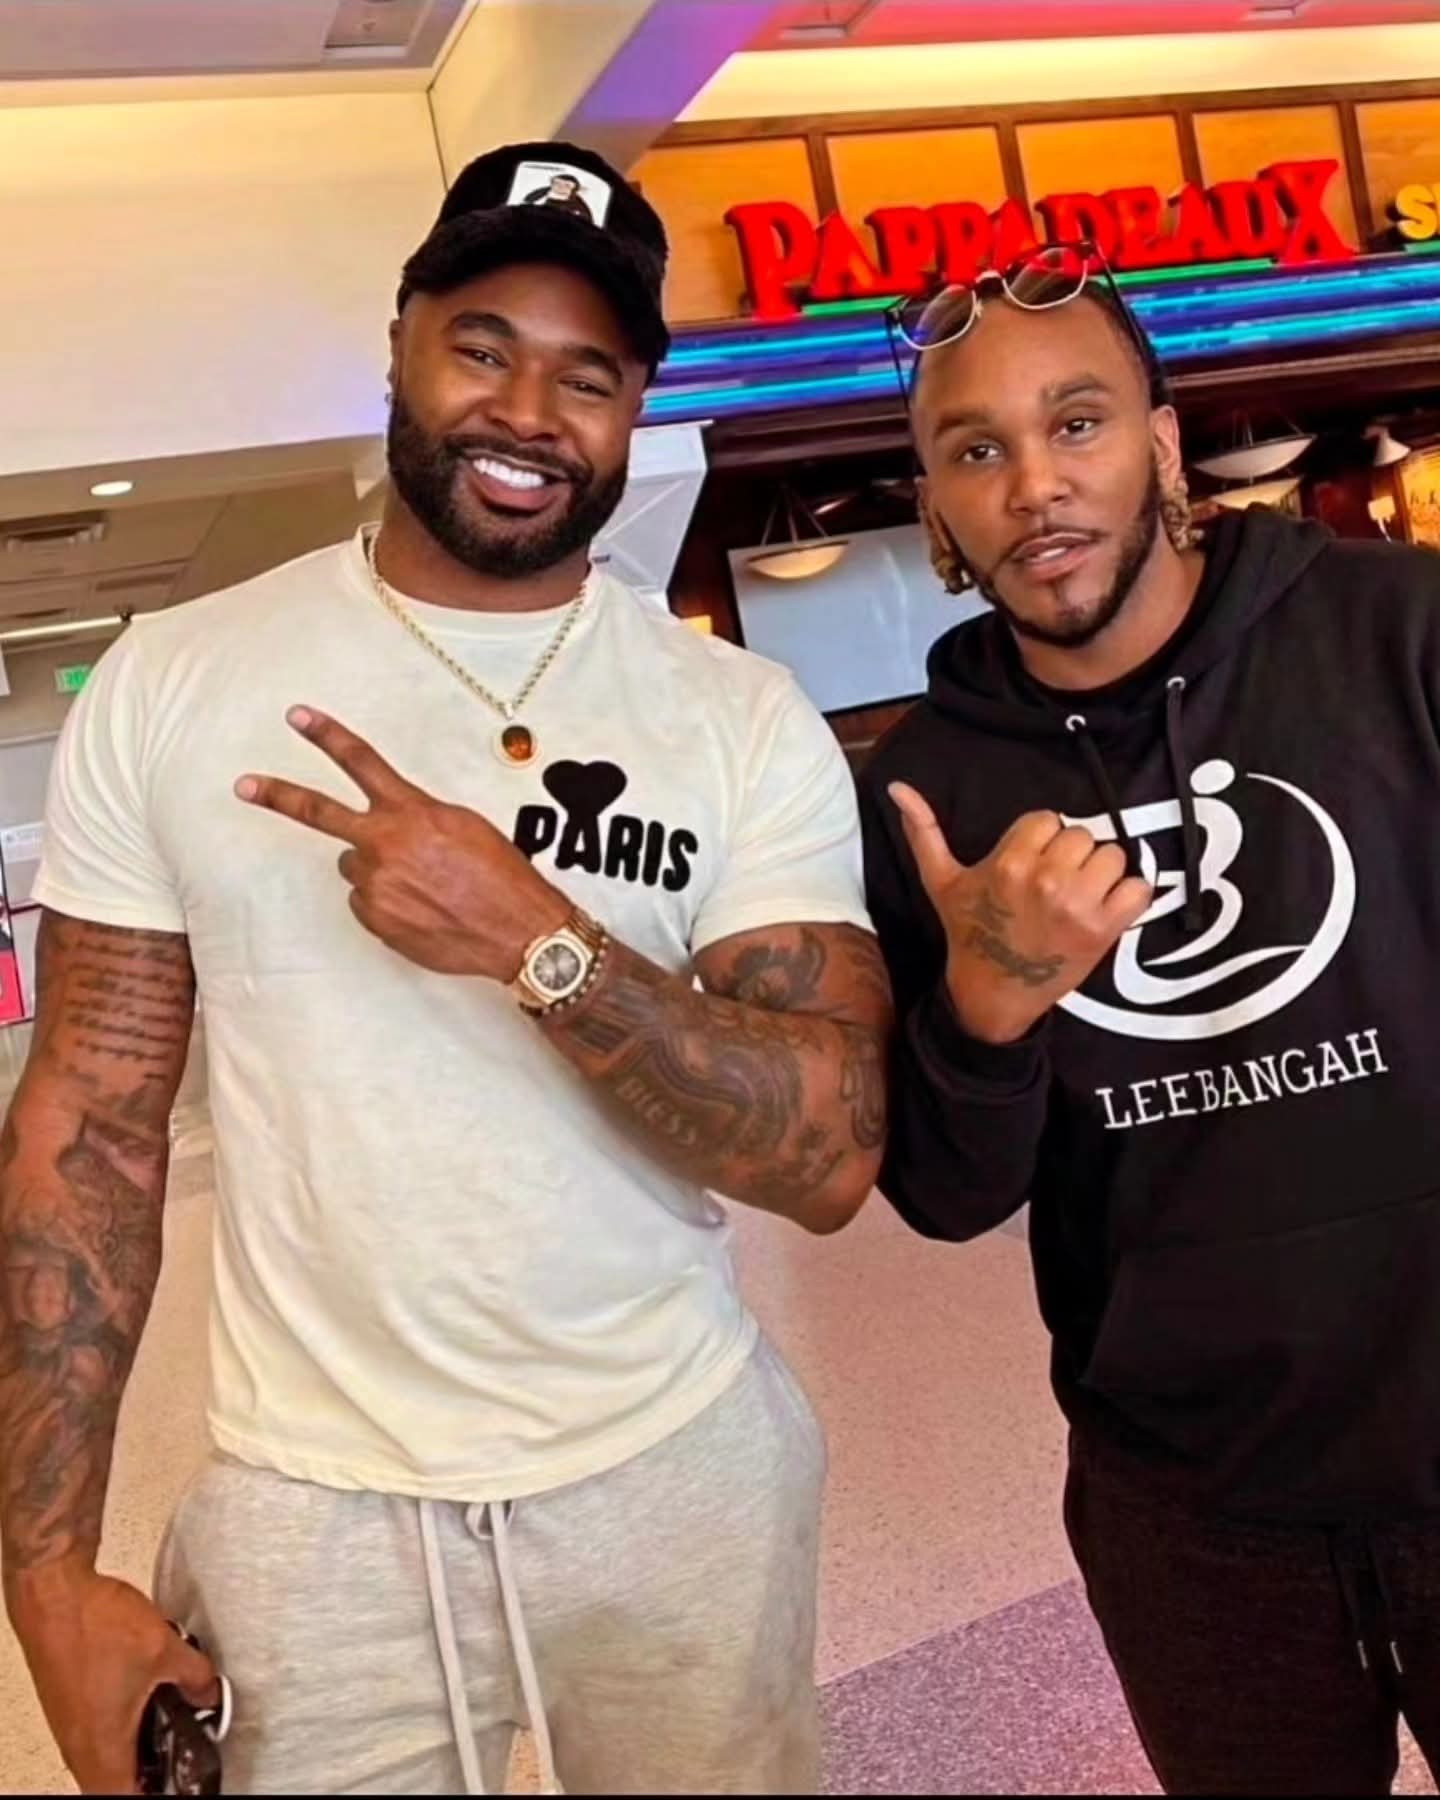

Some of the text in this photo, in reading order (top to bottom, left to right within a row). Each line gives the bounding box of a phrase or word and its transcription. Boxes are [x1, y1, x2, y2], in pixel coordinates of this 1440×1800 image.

[724, 158, 1440, 322] PAPPADEAUX S
[513, 803, 699, 892] PARIS
[1095, 1027, 1389, 1130] LEEBANGAH
